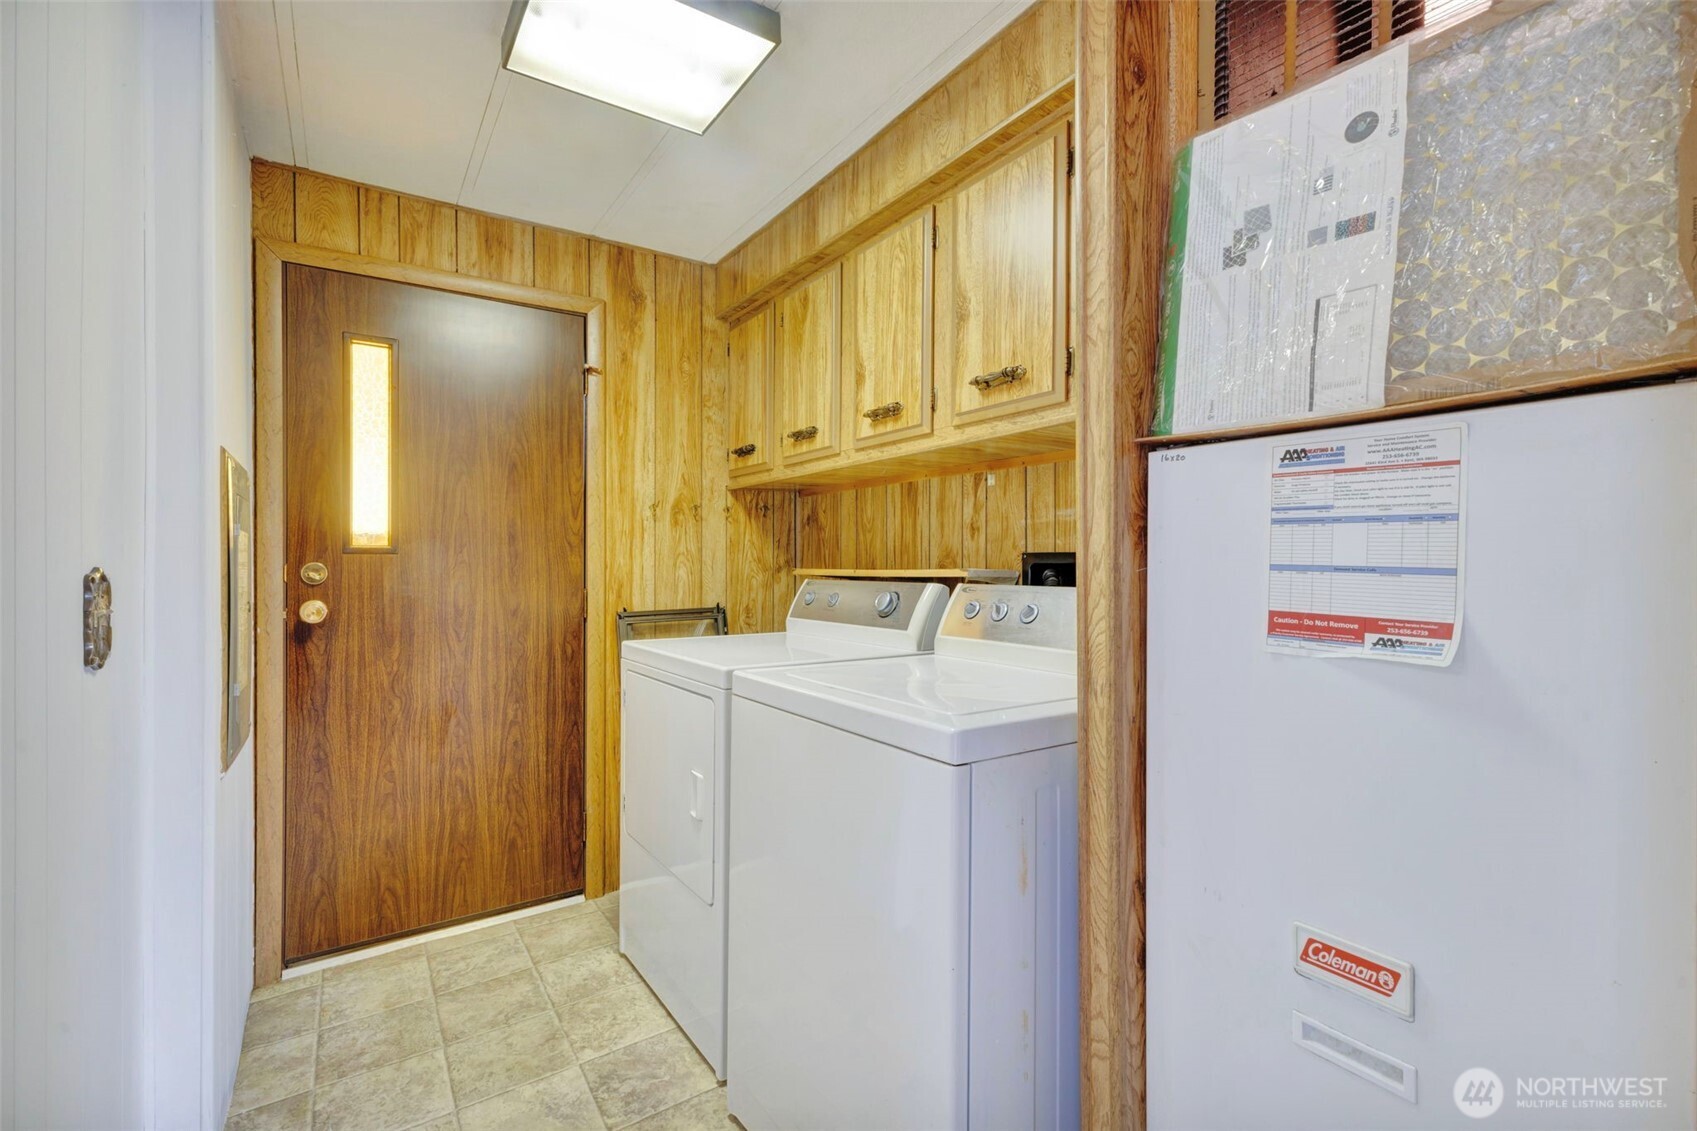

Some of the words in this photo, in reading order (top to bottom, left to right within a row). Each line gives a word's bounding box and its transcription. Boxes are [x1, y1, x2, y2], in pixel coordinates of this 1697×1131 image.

[1160, 453, 1186, 463] 16x20
[1279, 448, 1308, 462] AAA
[1273, 616, 1299, 624] Caution
[1329, 621, 1359, 630] Remove
[1387, 627, 1429, 636] 253-656-6739
[1371, 637, 1403, 648] AAA
[1307, 942, 1378, 983] Coleman
